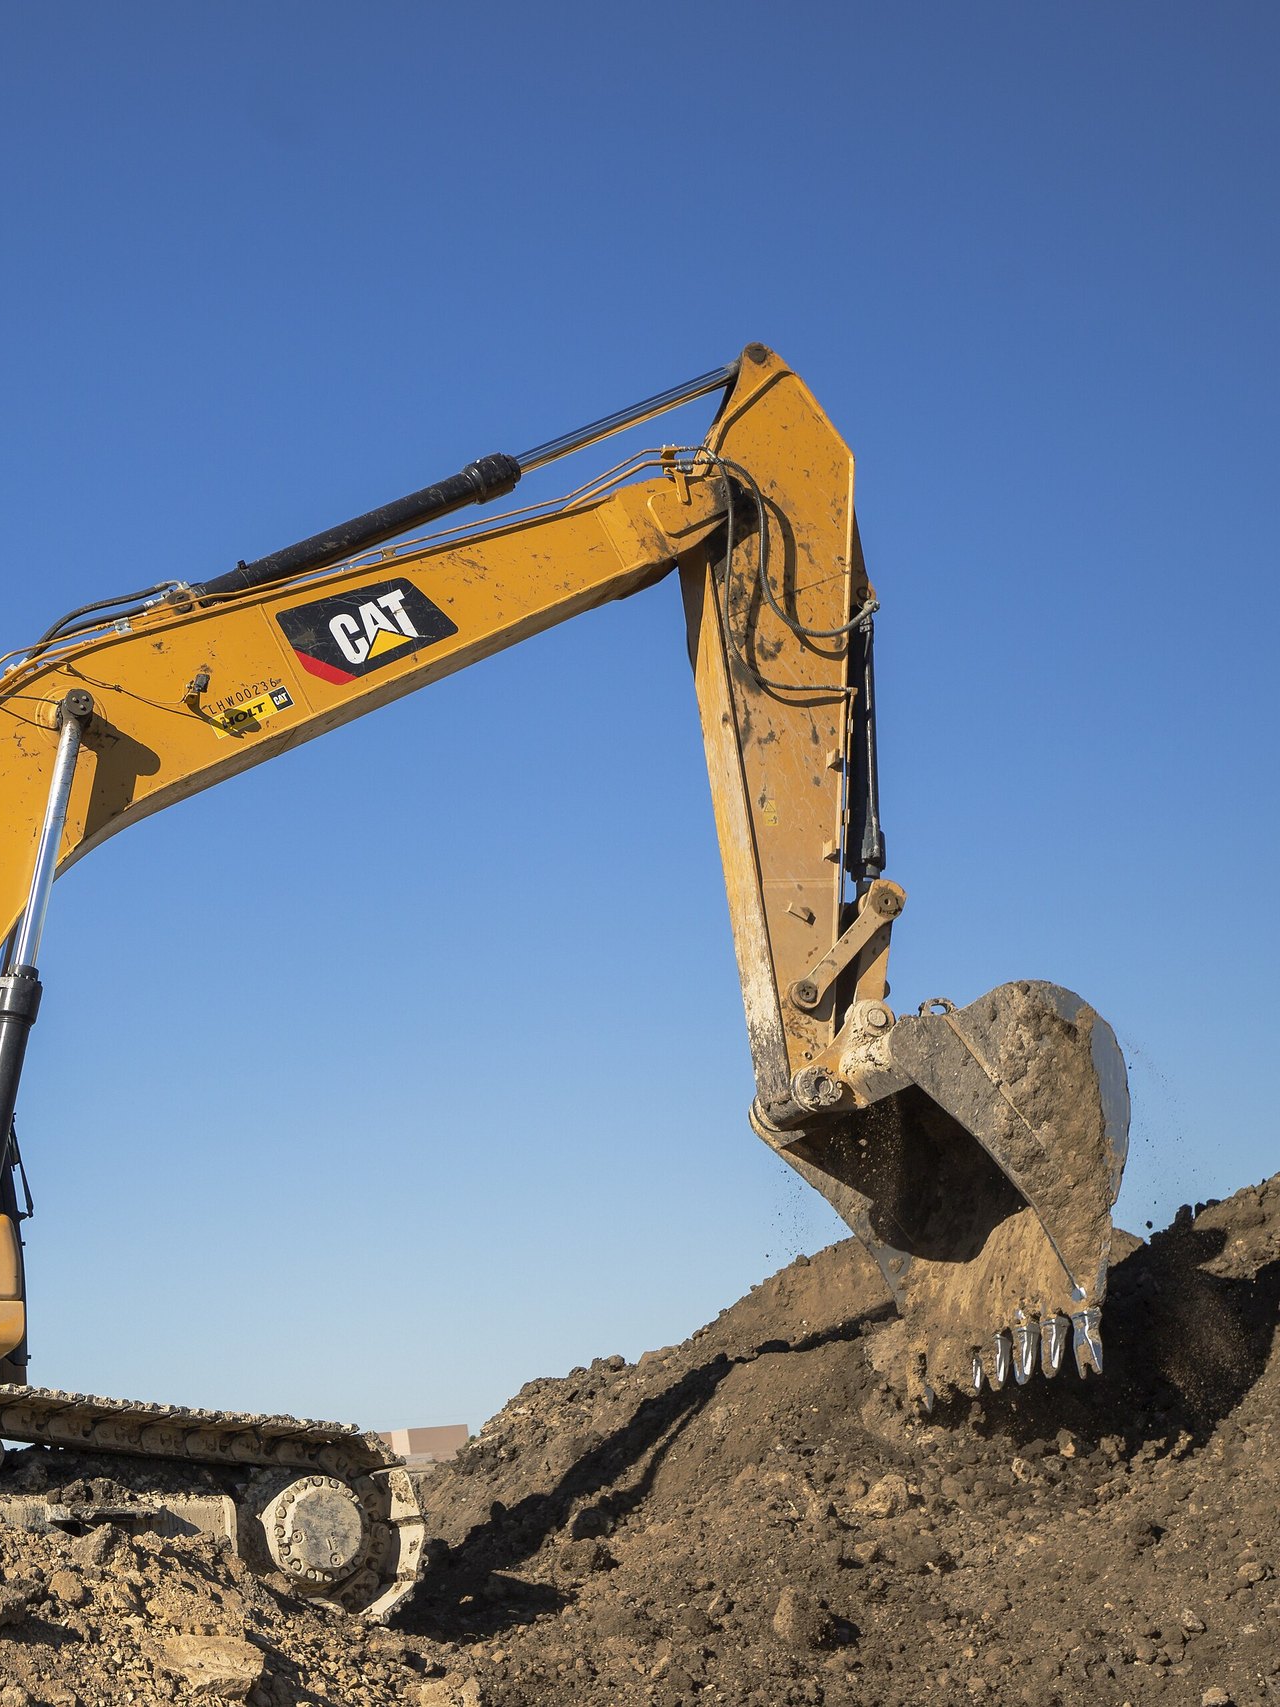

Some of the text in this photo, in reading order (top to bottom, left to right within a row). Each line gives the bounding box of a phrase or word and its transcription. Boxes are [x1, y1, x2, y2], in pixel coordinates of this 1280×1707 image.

[329, 589, 419, 665] CAT
[220, 692, 288, 729] HOLT CAT
